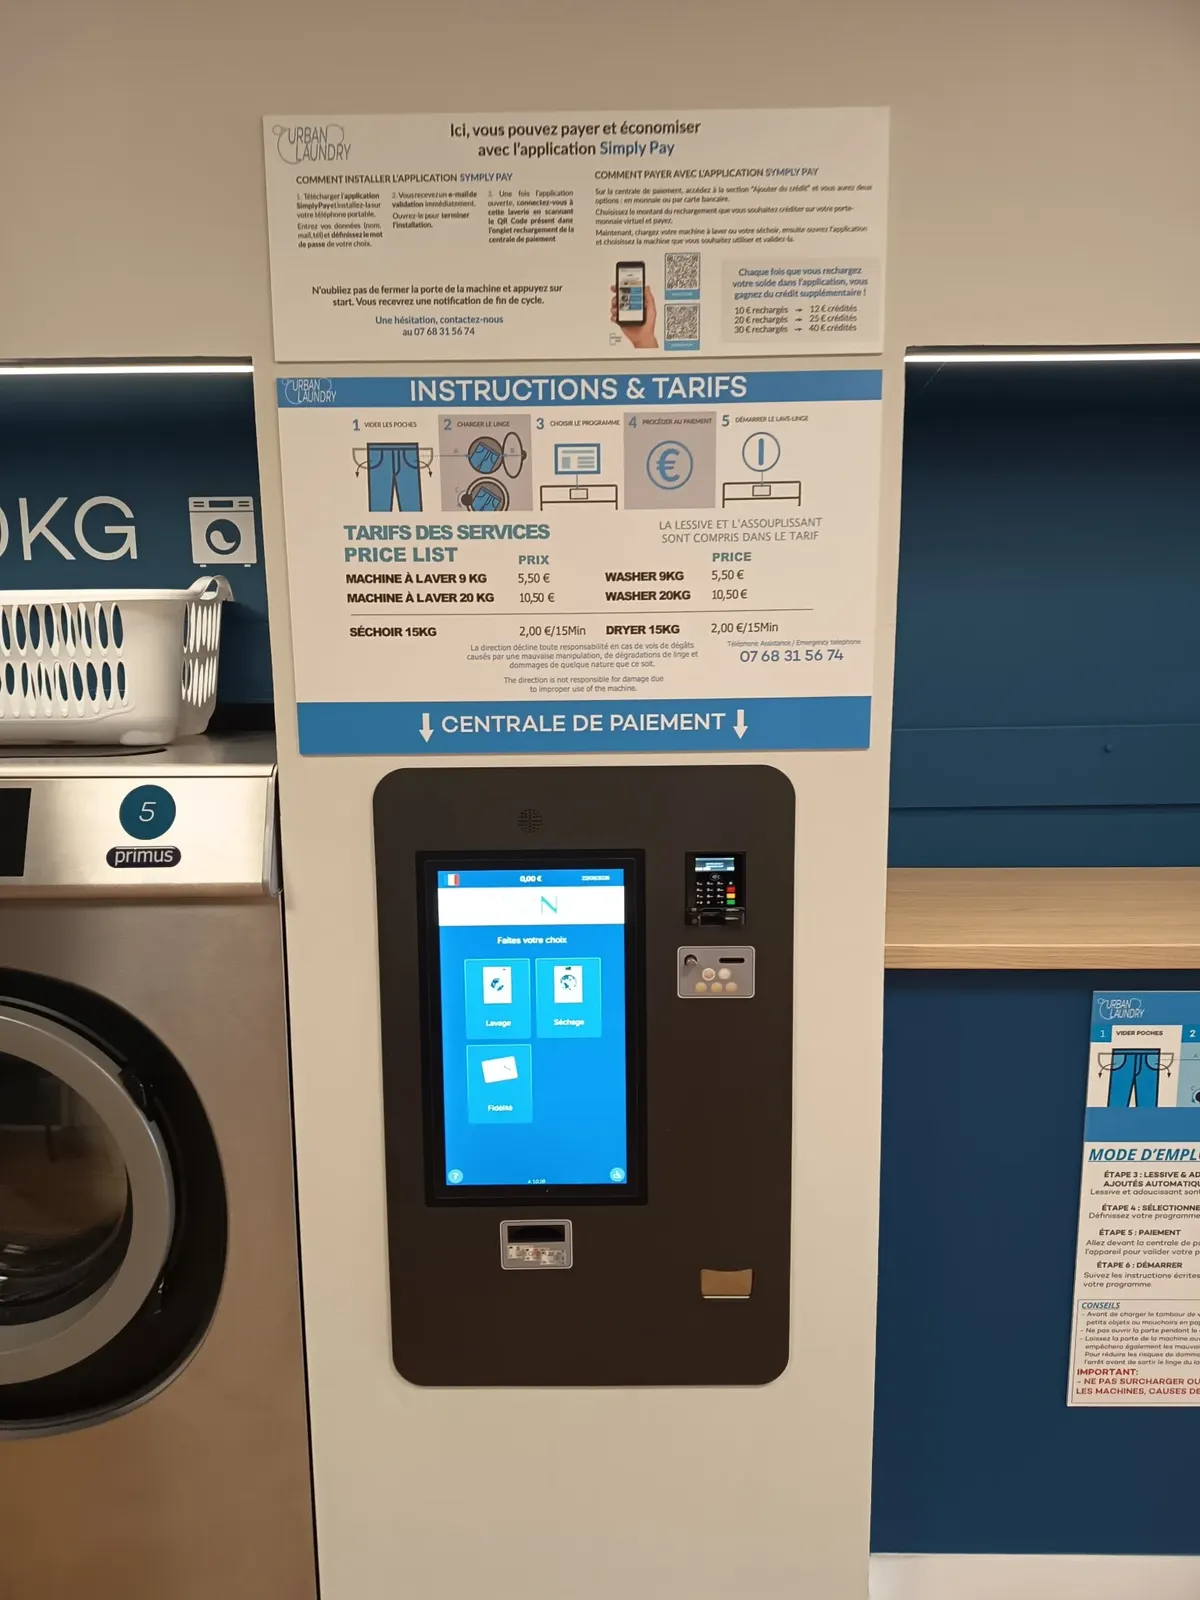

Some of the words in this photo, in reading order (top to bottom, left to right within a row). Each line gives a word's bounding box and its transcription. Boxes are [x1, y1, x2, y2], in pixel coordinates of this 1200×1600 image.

[288, 126, 327, 144] URBAN
[450, 123, 470, 138] Ici,
[472, 125, 505, 137] vous
[508, 124, 558, 139] pouvez
[561, 124, 600, 139] payer
[603, 123, 617, 135] et
[620, 120, 701, 135] économiser
[296, 144, 351, 161] LAUNDRY
[478, 144, 510, 156] avec
[513, 142, 596, 158] l'application
[599, 141, 646, 157] Simply
[650, 141, 675, 156] Pay
[296, 175, 343, 185] COMMENT
[345, 175, 391, 184] INSTALLER
[392, 173, 457, 183] L'APPLICATION
[460, 173, 495, 183] SYMPLY
[495, 173, 513, 181] PAY
[595, 171, 643, 179] COMMENT
[644, 170, 672, 178] PAYER
[674, 170, 697, 178] AVEC
[699, 169, 764, 177] L'APPLICATION
[765, 168, 800, 177] SYMPLY
[802, 168, 819, 176] PAY
[312, 285, 351, 295] N'oubliez
[353, 287, 367, 296] pas
[369, 285, 379, 294] de
[381, 285, 409, 294] fermer
[411, 285, 419, 293] la
[420, 285, 443, 295] porte
[444, 285, 455, 293] de
[457, 285, 464, 293] la
[466, 284, 501, 293] machine
[502, 285, 511, 293] et
[513, 285, 547, 295] appuyez
[549, 284, 563, 292] sur
[333, 298, 354, 307] start.
[356, 297, 376, 306] Vous
[433, 296, 481, 305] notification
[483, 296, 493, 304] de
[495, 296, 506, 304] fin
[508, 296, 519, 304] de
[521, 295, 544, 306] cycle.
[376, 316, 392, 325] Une
[394, 316, 438, 325] hésitation,
[440, 315, 503, 324] contactez-nous
[402, 328, 412, 336] au
[414, 328, 425, 336] 07
[426, 328, 437, 336] 68
[439, 327, 450, 336] 31
[451, 327, 462, 335] 56
[464, 327, 475, 335] 74
[292, 378, 321, 391] URBAN
[410, 379, 618, 402] INSTRUCTIONS
[626, 377, 646, 399] &
[652, 375, 747, 399] TARIFS
[297, 391, 336, 403] LAUNDRY
[352, 419, 360, 431] 1
[444, 419, 452, 430] 2
[536, 418, 544, 429] 3
[628, 417, 637, 428] 4
[721, 415, 730, 427] 5
[0, 496, 138, 560] KG
[659, 521, 672, 530] LA
[675, 520, 713, 530] LESSIVE
[717, 520, 728, 529] ET
[732, 518, 823, 529] L'ASSOUPLISSANT
[343, 525, 411, 540] TARIFS
[416, 525, 453, 540] DES
[457, 524, 550, 540] SERVICES
[662, 534, 690, 543] SONT
[693, 533, 739, 543] COMPRIS
[743, 532, 771, 542] DANS
[775, 531, 786, 541] LE
[790, 531, 819, 541] TARIF
[345, 547, 406, 562] PRICE
[413, 547, 458, 562] LIST
[518, 555, 549, 565] PRIX
[712, 552, 752, 562] PRICE
[346, 574, 402, 584] MACHINE
[405, 572, 414, 583] À
[416, 574, 457, 583] LAVER
[459, 574, 466, 583] 9
[469, 574, 487, 583] KG
[518, 573, 540, 585] 5,50
[543, 573, 550, 583] €
[605, 572, 656, 582] WASHER
[659, 571, 684, 581] 9KG
[711, 570, 734, 581] 5,50
[737, 570, 744, 579] €
[347, 593, 403, 603] MACHINE
[405, 591, 414, 603] À
[417, 593, 458, 603] LAVER
[460, 593, 474, 603] 20
[476, 593, 494, 602] KG
[520, 593, 544, 604] 10,50
[548, 593, 555, 602] €
[605, 591, 657, 601] WASHER
[659, 591, 691, 600] 20KG
[712, 589, 739, 600] 10,50
[741, 589, 748, 599] €
[350, 625, 403, 637] SÉCHOIR
[405, 627, 437, 637] 15KG
[519, 627, 542, 637] 2,00
[544, 626, 586, 637] €/15Min
[606, 625, 646, 635] DRYER
[649, 624, 680, 634] 15KG
[711, 623, 734, 634] 2,00
[736, 622, 778, 633] €/15Min
[740, 651, 758, 662] 07
[761, 650, 780, 662] 68
[784, 650, 801, 662] 31
[805, 649, 823, 661] 56
[827, 649, 844, 660] 74
[442, 715, 566, 733] CENTRALE
[573, 715, 603, 731] DE
[610, 713, 725, 731] PAIEMENT
[139, 801, 156, 822] 5
[114, 848, 174, 866] primus
[520, 875, 535, 883] 0,00
[497, 936, 521, 944] Faites
[1106, 1000, 1131, 1008] URBAN
[1110, 1009, 1145, 1018] LAUNDRY
[486, 1020, 511, 1028] Lavage
[553, 1018, 584, 1026] Séchage
[1100, 1030, 1105, 1038] 1
[1089, 1149, 1137, 1161] MODE
[1141, 1149, 1200, 1161] D'EMPL
[1099, 1228, 1126, 1236] ÉTAPE
